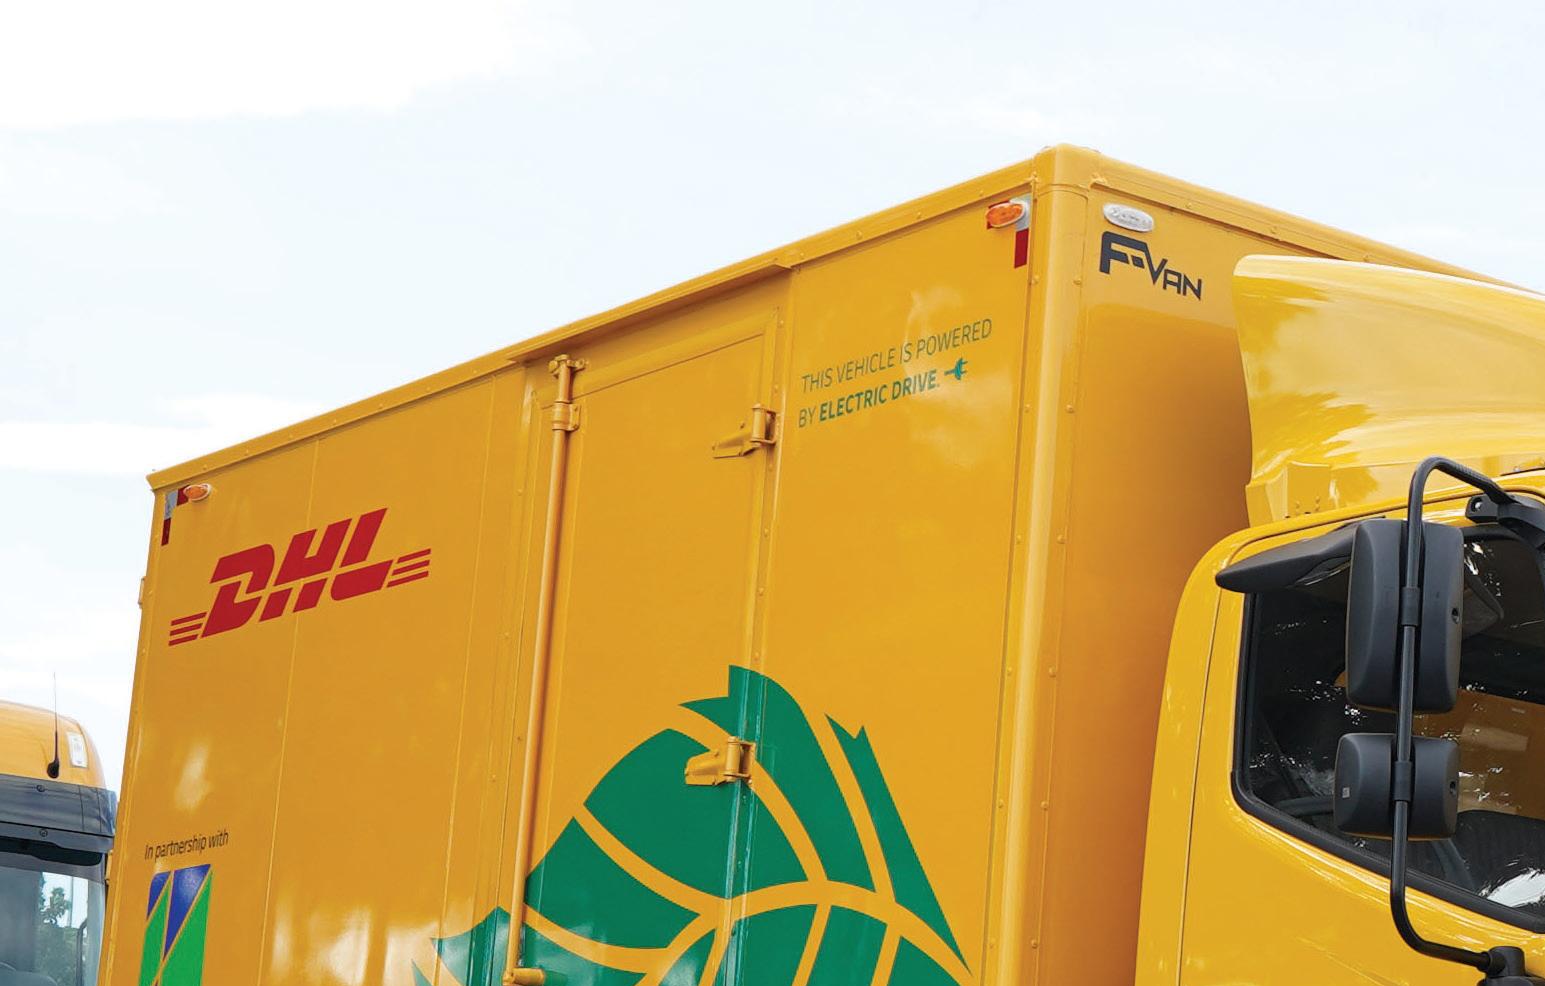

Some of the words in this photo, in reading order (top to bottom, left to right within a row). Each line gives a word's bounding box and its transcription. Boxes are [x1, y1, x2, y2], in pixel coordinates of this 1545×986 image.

[802, 368, 833, 393] THIS
[836, 348, 896, 383] VEHICLE
[899, 342, 913, 364] IS
[916, 318, 993, 359] POWERED
[798, 407, 816, 428] BY
[819, 384, 888, 421] ELECTRIC
[892, 369, 941, 400] DRIVE.
[200, 507, 389, 639] DHL
[144, 844, 154, 860] In
[155, 834, 207, 862] partnership
[207, 829, 230, 849] with
